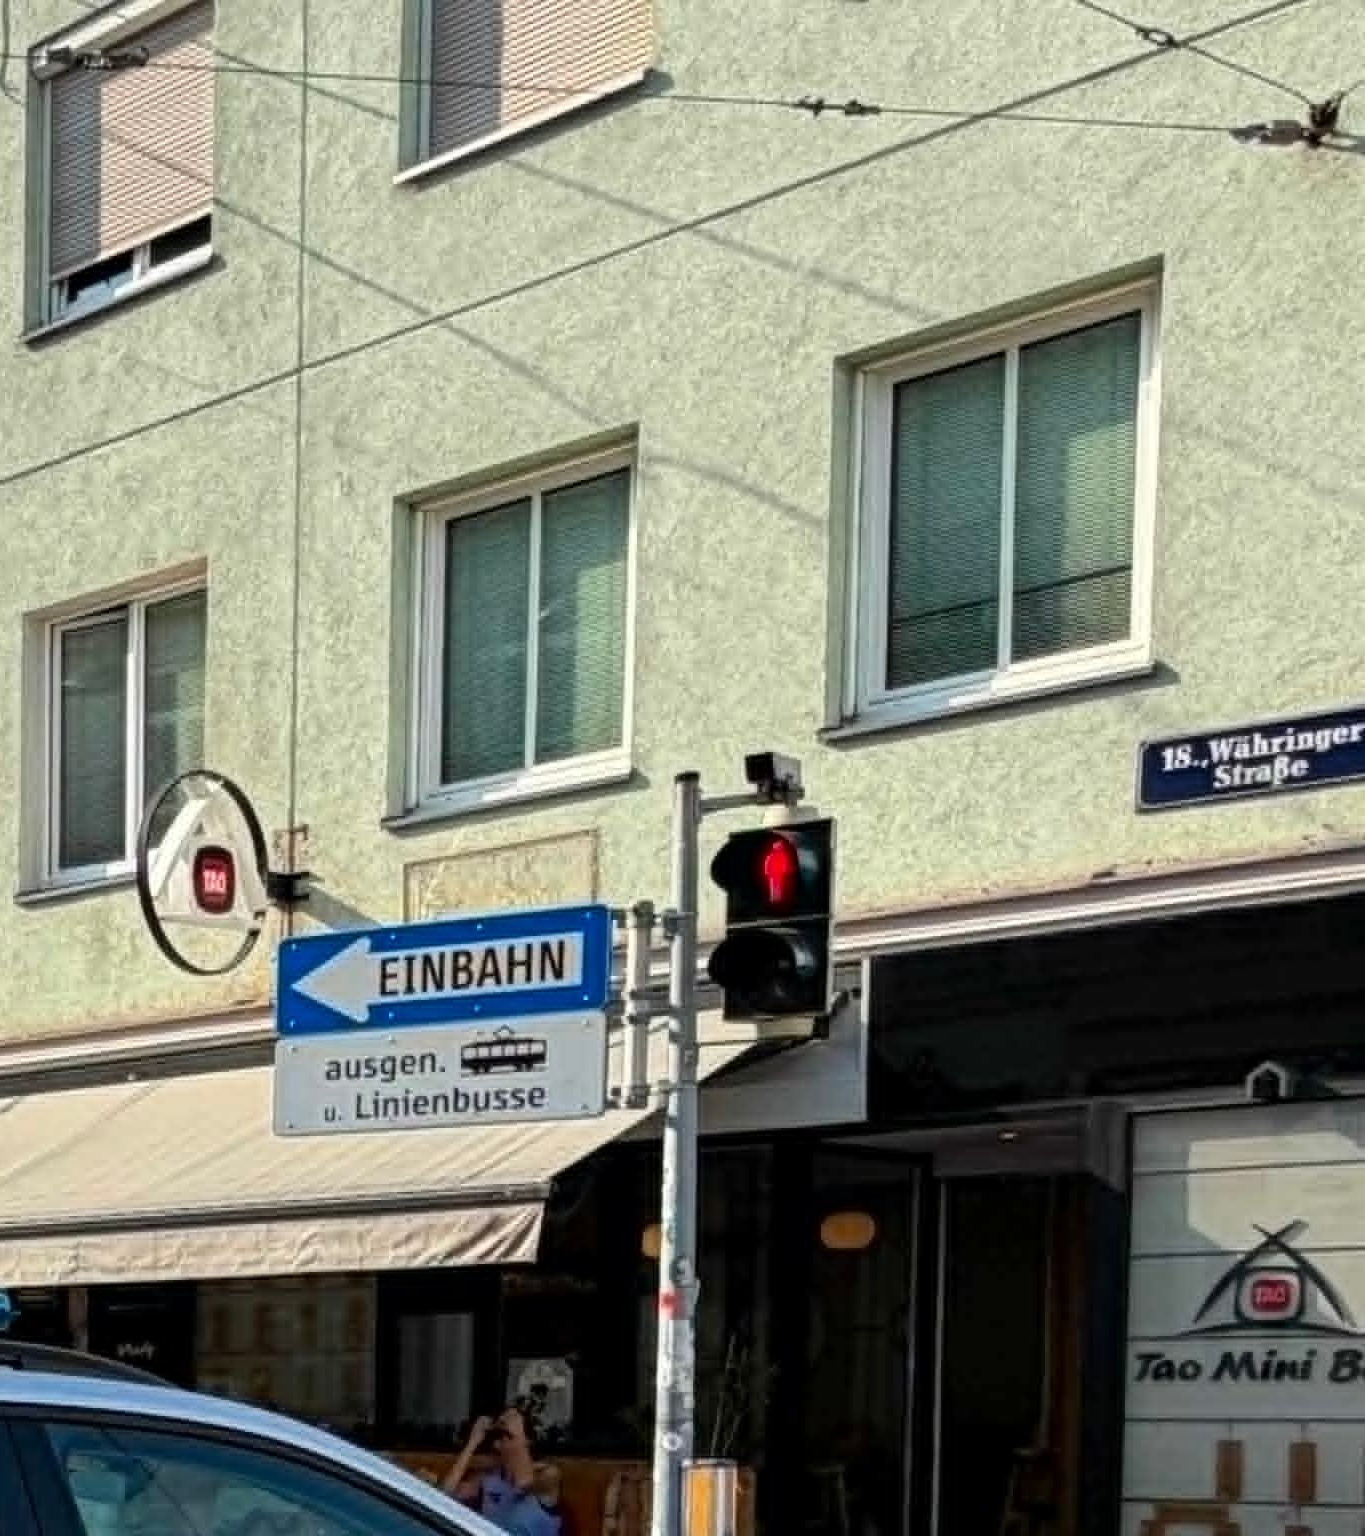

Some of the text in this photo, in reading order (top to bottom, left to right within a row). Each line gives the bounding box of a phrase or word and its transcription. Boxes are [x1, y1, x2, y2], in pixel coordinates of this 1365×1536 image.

[1208, 722, 1365, 763] Währinger
[1212, 754, 1310, 789] Straße
[378, 938, 566, 998] EINBAHN
[324, 1049, 447, 1083] ausgen.
[324, 1084, 549, 1123] u. Linienbusse
[1134, 1352, 1203, 1382] Tao
[1212, 1349, 1318, 1382] Mini
